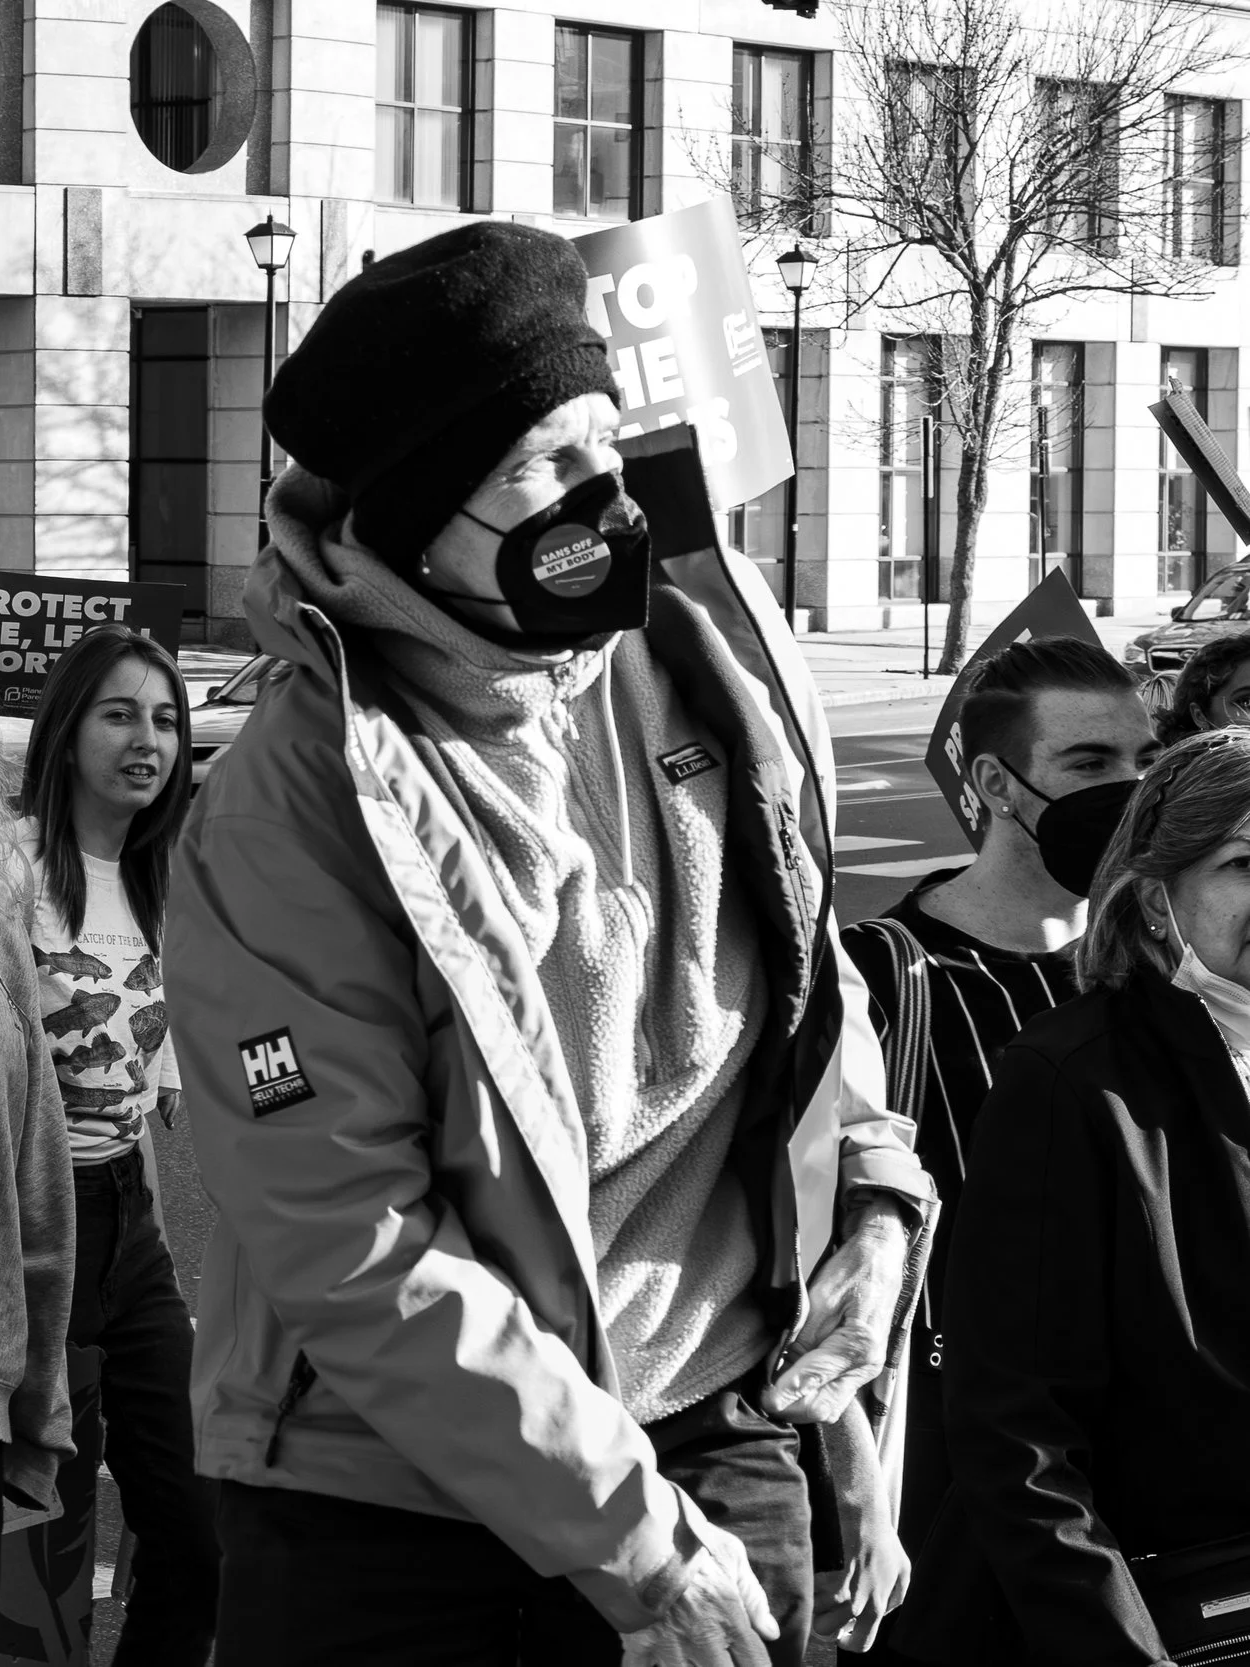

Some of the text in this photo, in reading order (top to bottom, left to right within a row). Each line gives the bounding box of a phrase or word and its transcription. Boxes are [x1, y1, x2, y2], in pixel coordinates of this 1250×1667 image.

[585, 253, 698, 338] TOP
[612, 335, 685, 410] HE
[541, 538, 593, 564] BANS OFF
[546, 550, 596, 574] MY BODY
[77, 933, 104, 944] CATCH
[106, 934, 117, 945] OF
[119, 935, 131, 946] THE
[241, 1036, 298, 1086] HH
